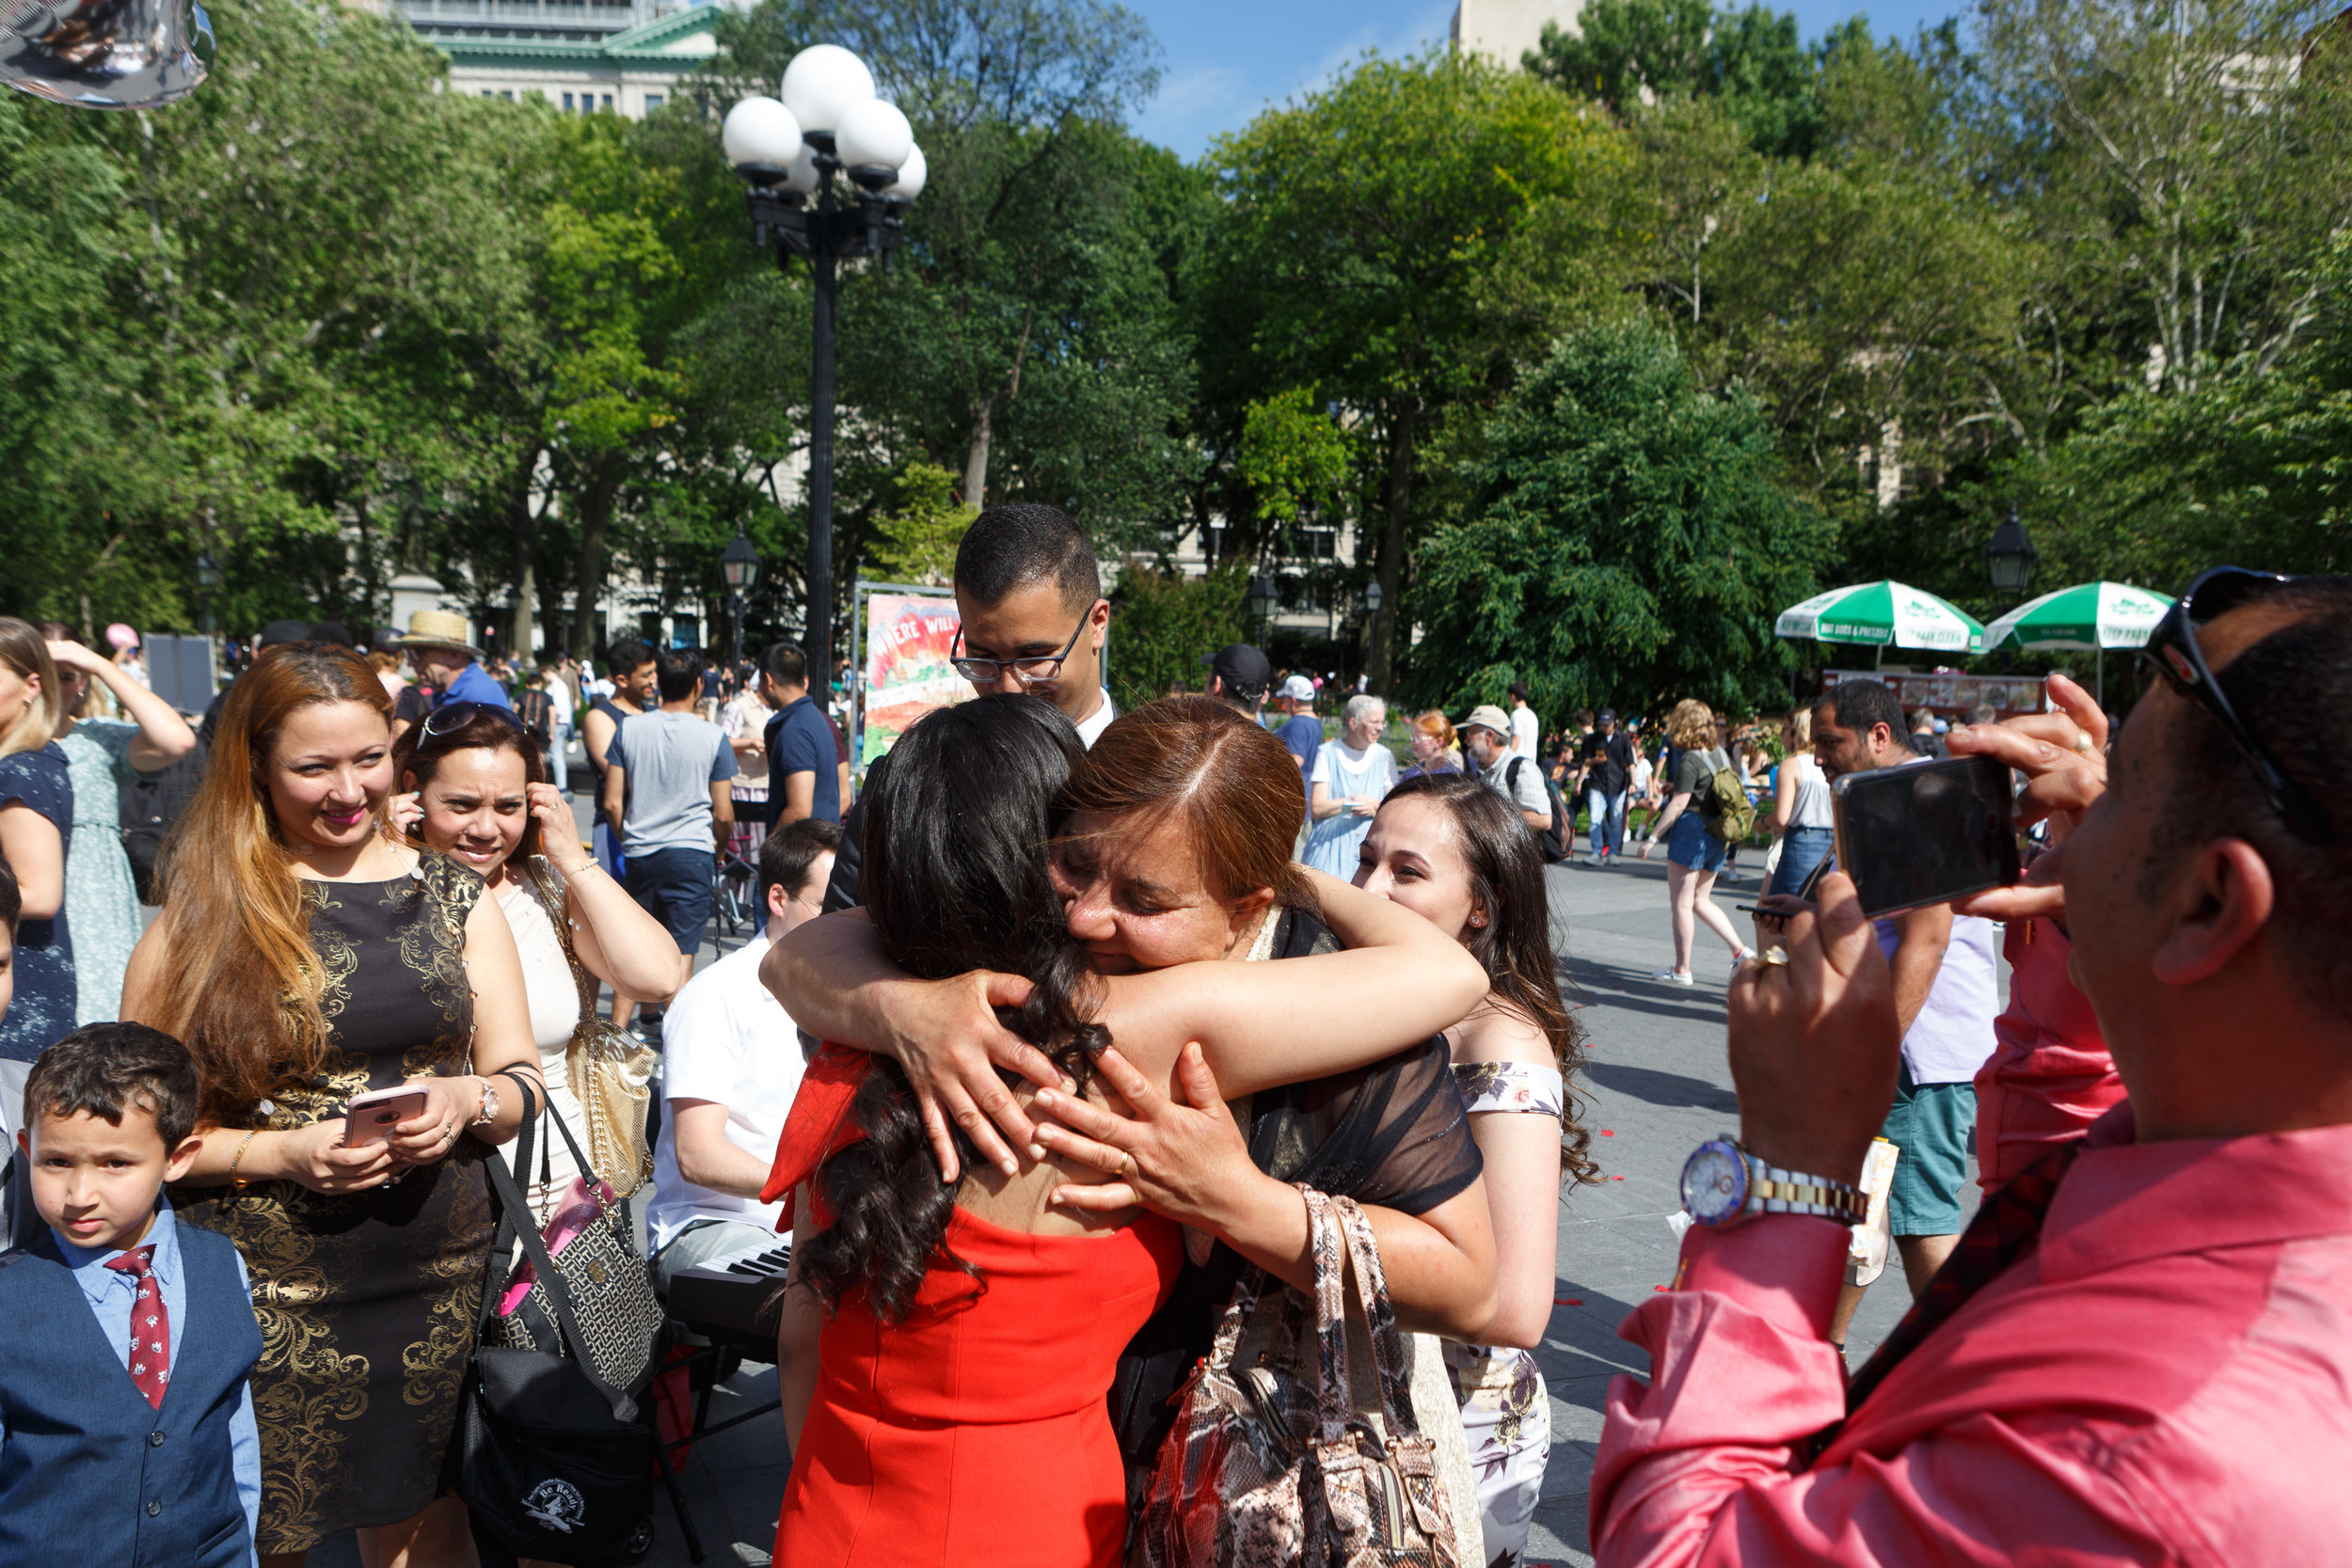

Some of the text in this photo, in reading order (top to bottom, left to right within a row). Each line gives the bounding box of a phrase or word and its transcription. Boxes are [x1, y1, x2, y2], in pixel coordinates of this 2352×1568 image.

[871, 621, 920, 656] WHERE
[924, 616, 955, 635] WILL
[539, 1486, 553, 1497] Be
[556, 1483, 578, 1510] Ready
